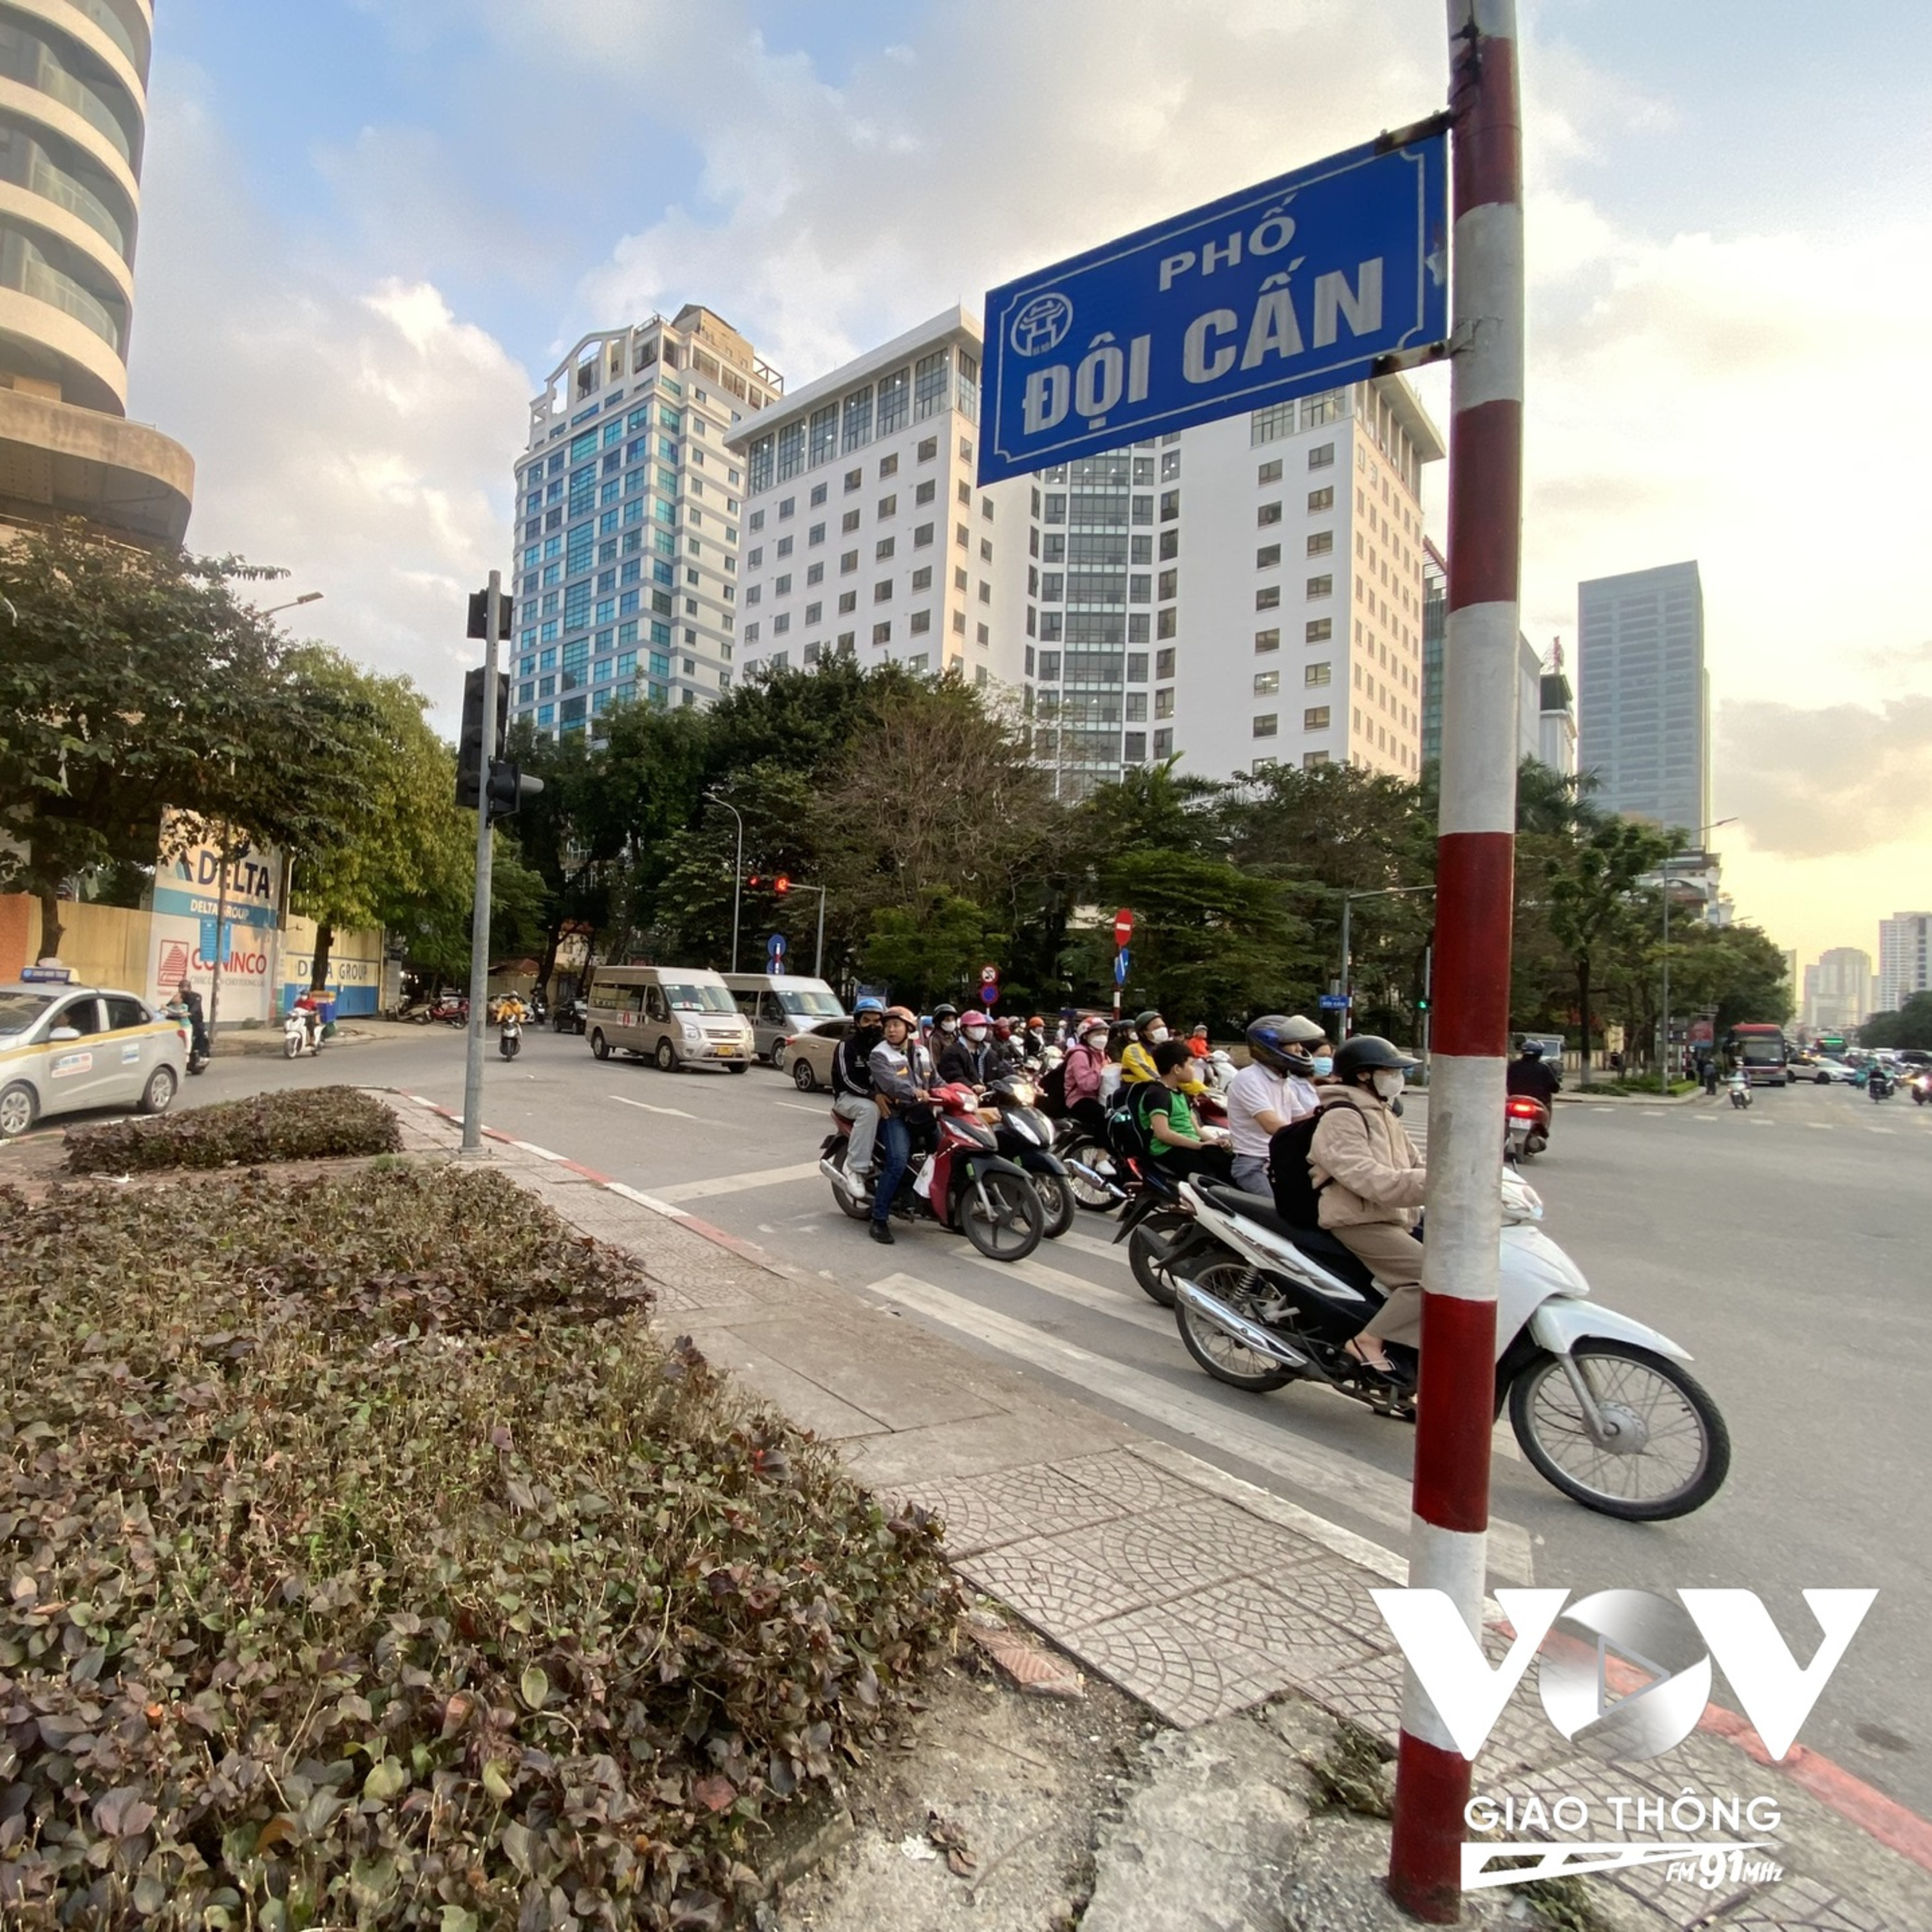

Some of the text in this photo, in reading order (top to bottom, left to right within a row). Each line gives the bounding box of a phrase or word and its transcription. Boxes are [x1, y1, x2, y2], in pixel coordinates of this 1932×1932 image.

[1159, 193, 1297, 292] PHỐ
[1021, 255, 1384, 436] ĐỘI CẤN
[190, 899, 249, 921] DELTA ROUP
[191, 948, 267, 974] CINCO
[339, 963, 368, 981] GROUP
